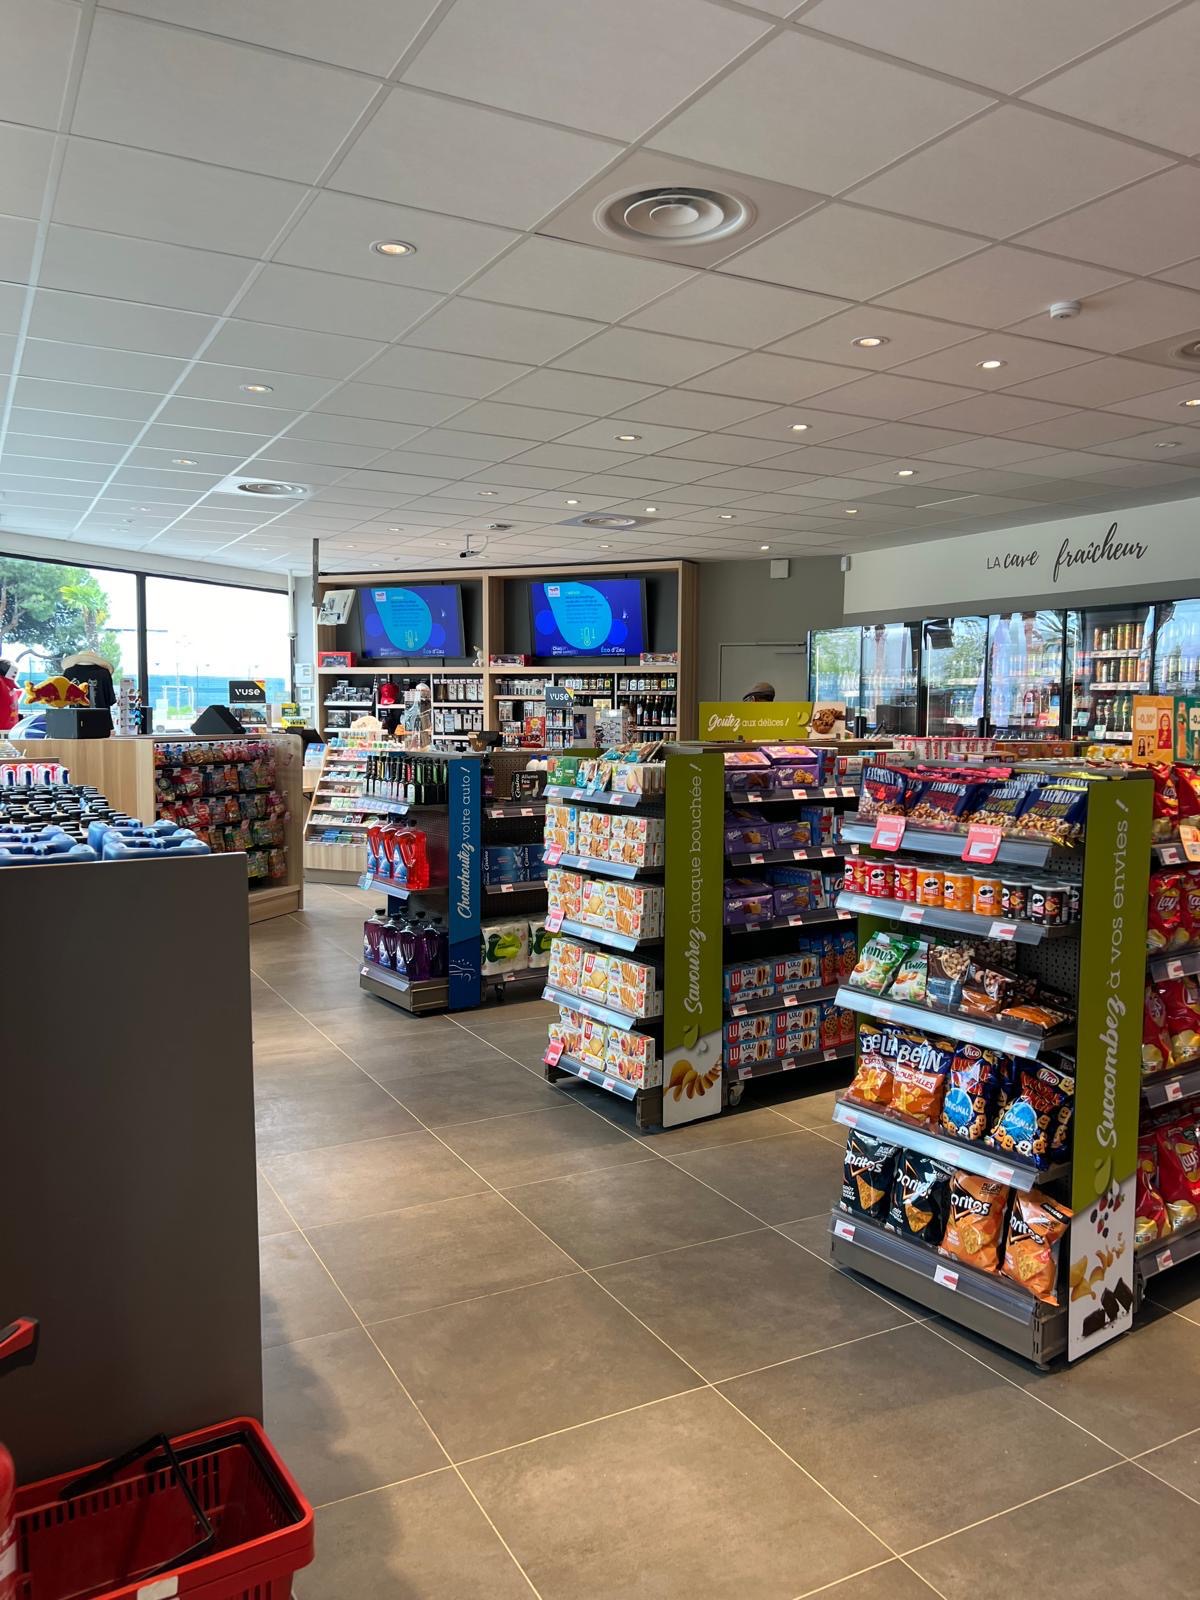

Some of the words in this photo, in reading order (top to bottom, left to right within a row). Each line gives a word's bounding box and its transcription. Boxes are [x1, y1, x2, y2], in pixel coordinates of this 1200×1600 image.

[986, 556, 1001, 570] LA
[1003, 550, 1040, 569] cave
[1052, 521, 1149, 583] fraîcheur
[234, 688, 261, 696] vuse
[741, 719, 757, 727] aux
[757, 717, 784, 727] délices
[461, 775, 471, 806] auto
[461, 808, 471, 841] votre
[689, 775, 703, 853] bouchée
[1113, 820, 1128, 909] envies
[456, 842, 475, 919] Chouchoutez
[690, 858, 704, 924] chaque
[1110, 916, 1123, 964] vos
[683, 926, 707, 1014] Savourez
[731, 972, 740, 987] LU
[775, 963, 784, 977] LU
[1106, 971, 1121, 989] à
[729, 1023, 738, 1038] LU
[777, 1014, 786, 1026] LU
[729, 1048, 739, 1061] LU
[776, 1037, 786, 1051] LU
[964, 1046, 980, 1057] Vico
[1039, 1071, 1057, 1085] Vico
[1096, 994, 1126, 1148] Succombez
[950, 1193, 991, 1216] oritos
[1010, 1216, 1045, 1244] oritos
